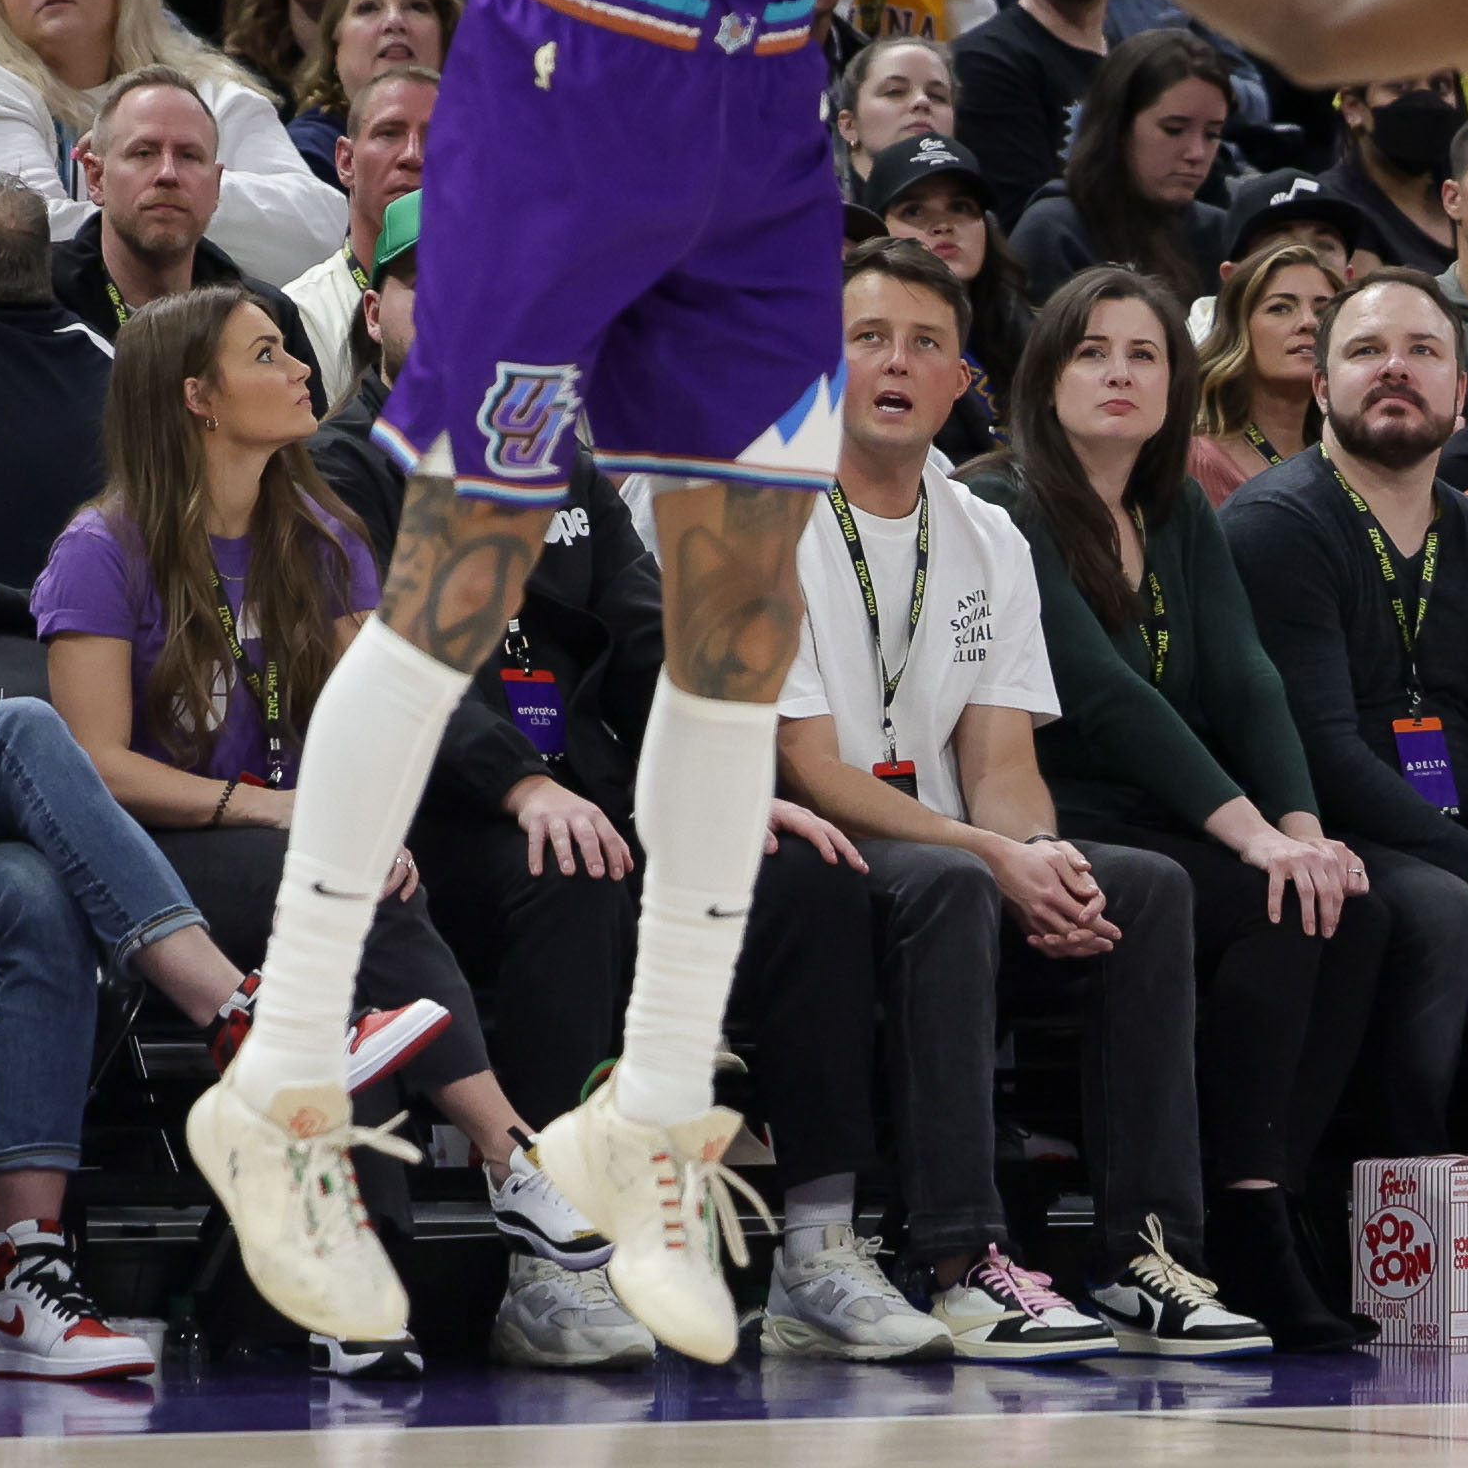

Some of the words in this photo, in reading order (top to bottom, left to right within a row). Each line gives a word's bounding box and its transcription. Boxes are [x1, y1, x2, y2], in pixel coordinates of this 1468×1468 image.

[831, 488, 847, 513] JAZZ
[1349, 491, 1368, 512] UTAH
[842, 517, 857, 542] UTAH
[1368, 527, 1385, 550] JAZZ
[1427, 532, 1438, 554] UTAH
[855, 559, 869, 583] JAZZ
[1380, 553, 1396, 581] UTAH
[1422, 557, 1435, 583] JAZZ
[916, 569, 926, 594] UTAH
[864, 591, 877, 616] UTAH
[911, 601, 921, 624] JAZZ
[957, 589, 986, 613] ANTI
[1392, 597, 1406, 622] JAZZ
[954, 623, 993, 648] SCIAL
[1158, 629, 1169, 653] JAZZ
[267, 693, 279, 720] JAZZ
[517, 705, 557, 716] entrata
[1415, 760, 1447, 770] DELTA
[1378, 1169, 1417, 1205] fresh
[1365, 1213, 1415, 1258] POP
[1369, 1241, 1432, 1288] CORN
[1356, 1300, 1407, 1320] DELICIOUS
[1410, 1323, 1440, 1341] CRISP
